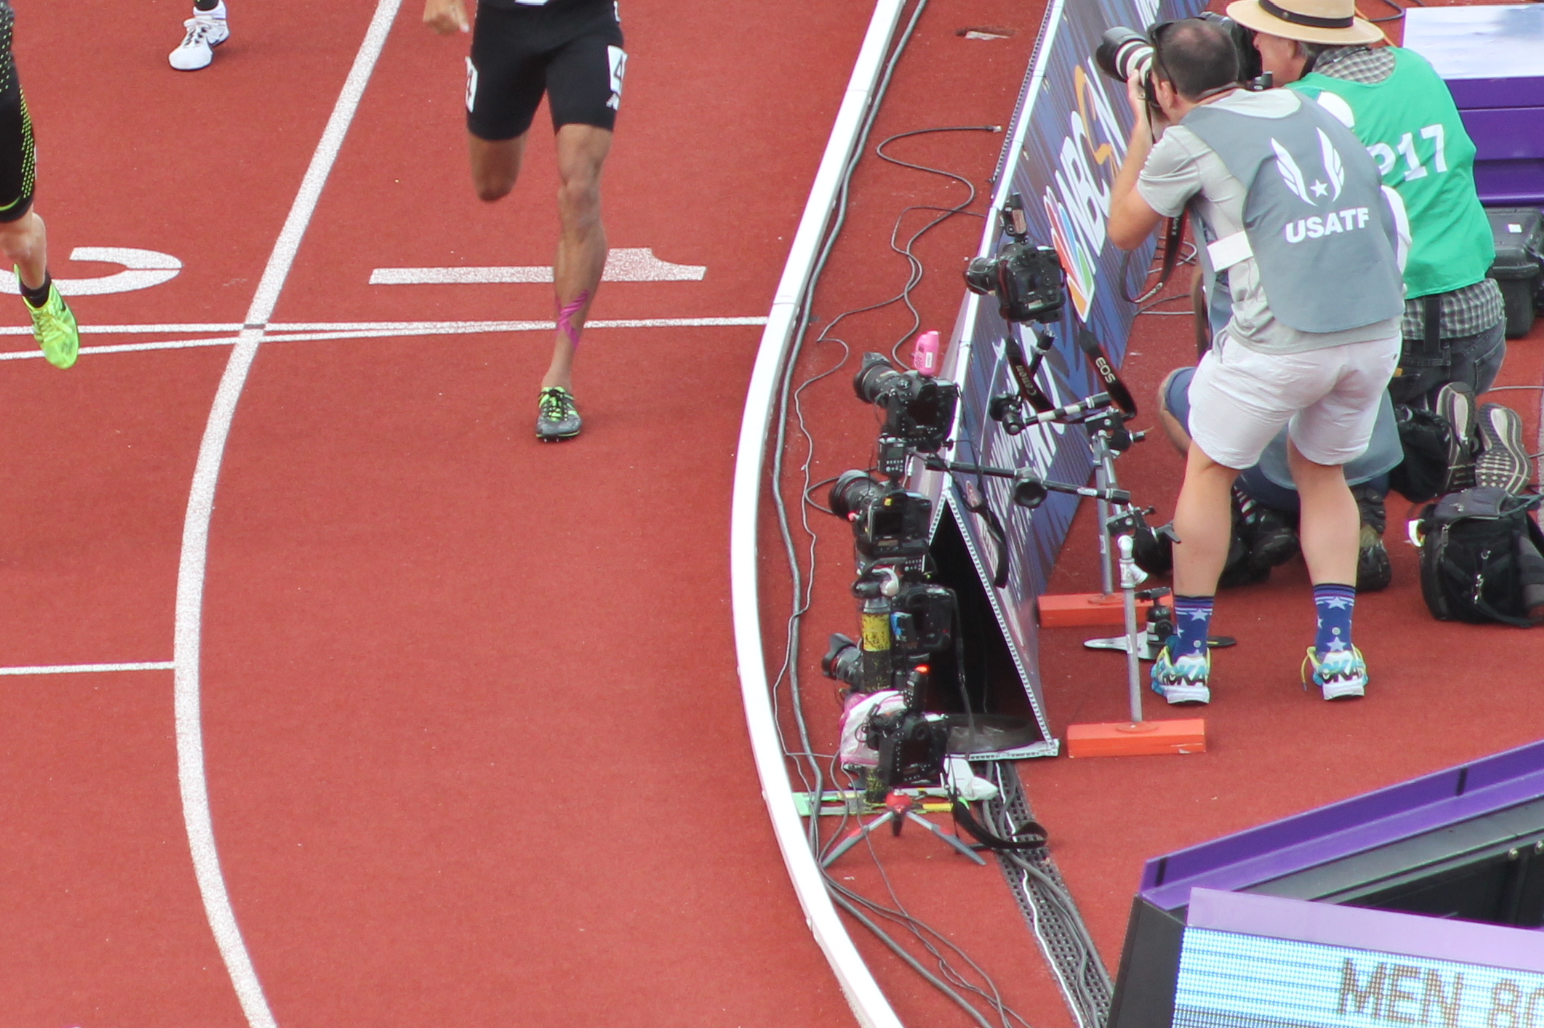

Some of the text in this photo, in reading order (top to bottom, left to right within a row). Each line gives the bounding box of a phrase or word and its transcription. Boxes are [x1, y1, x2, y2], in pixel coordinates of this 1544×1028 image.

[1285, 207, 1370, 244] USATF
[1015, 364, 1037, 397] Canon
[1095, 356, 1116, 384] EOS
[1335, 957, 1464, 1028] MEN
